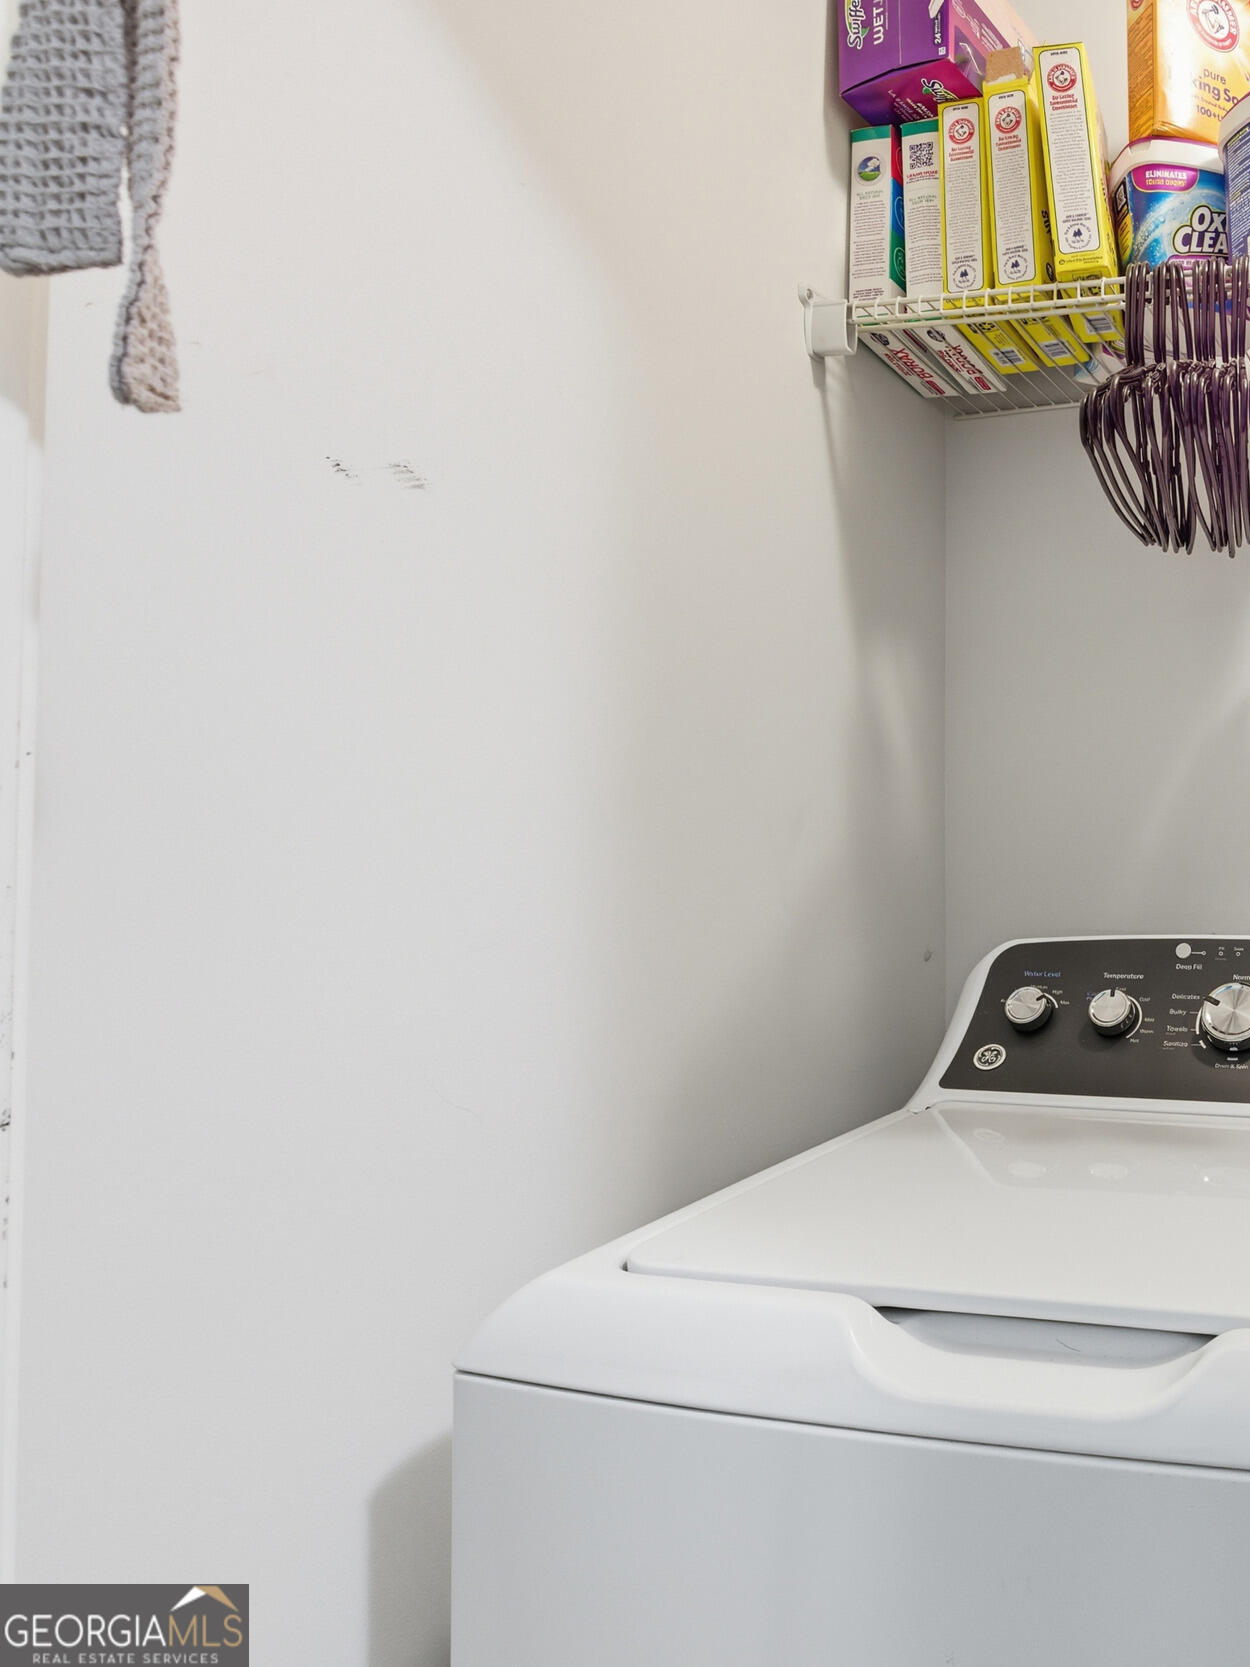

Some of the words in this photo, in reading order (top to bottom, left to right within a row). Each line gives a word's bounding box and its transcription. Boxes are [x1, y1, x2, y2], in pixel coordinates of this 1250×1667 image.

[1191, 205, 1227, 233] OX
[1173, 226, 1229, 254] CLEA
[1103, 972, 1144, 980] Temperature
